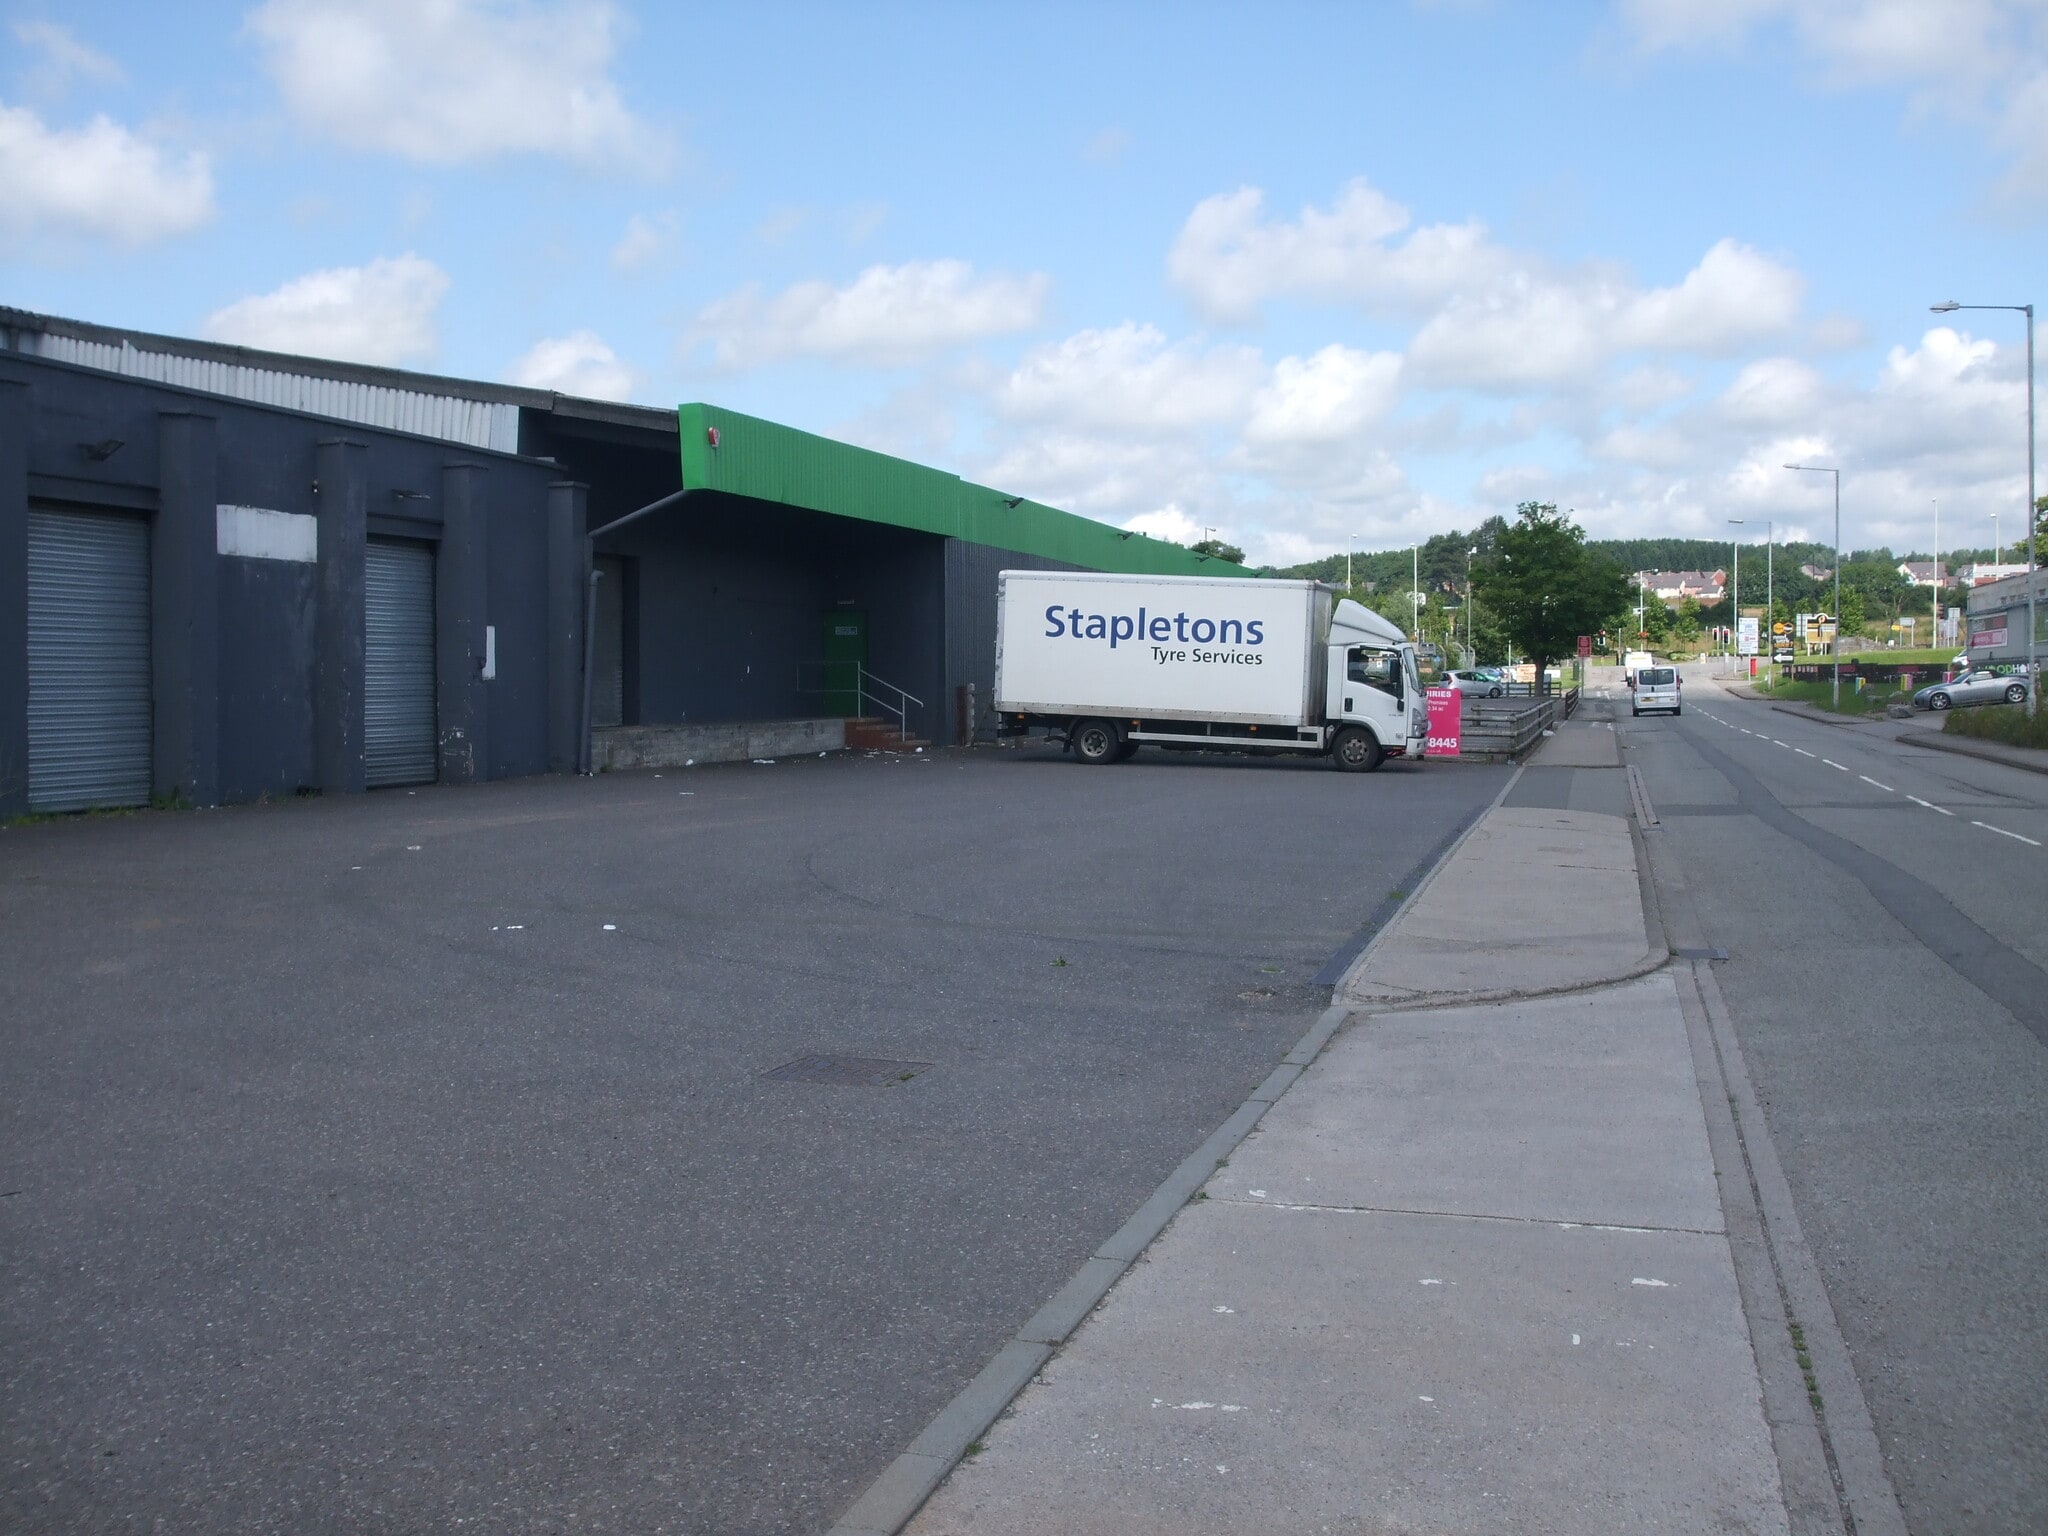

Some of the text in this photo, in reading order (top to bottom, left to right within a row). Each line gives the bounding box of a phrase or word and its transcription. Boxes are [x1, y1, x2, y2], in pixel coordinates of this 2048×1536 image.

[1045, 605, 1264, 649] Stapletons
[1150, 646, 1263, 665] Tyre Services
[1428, 737, 1457, 748] 8445
